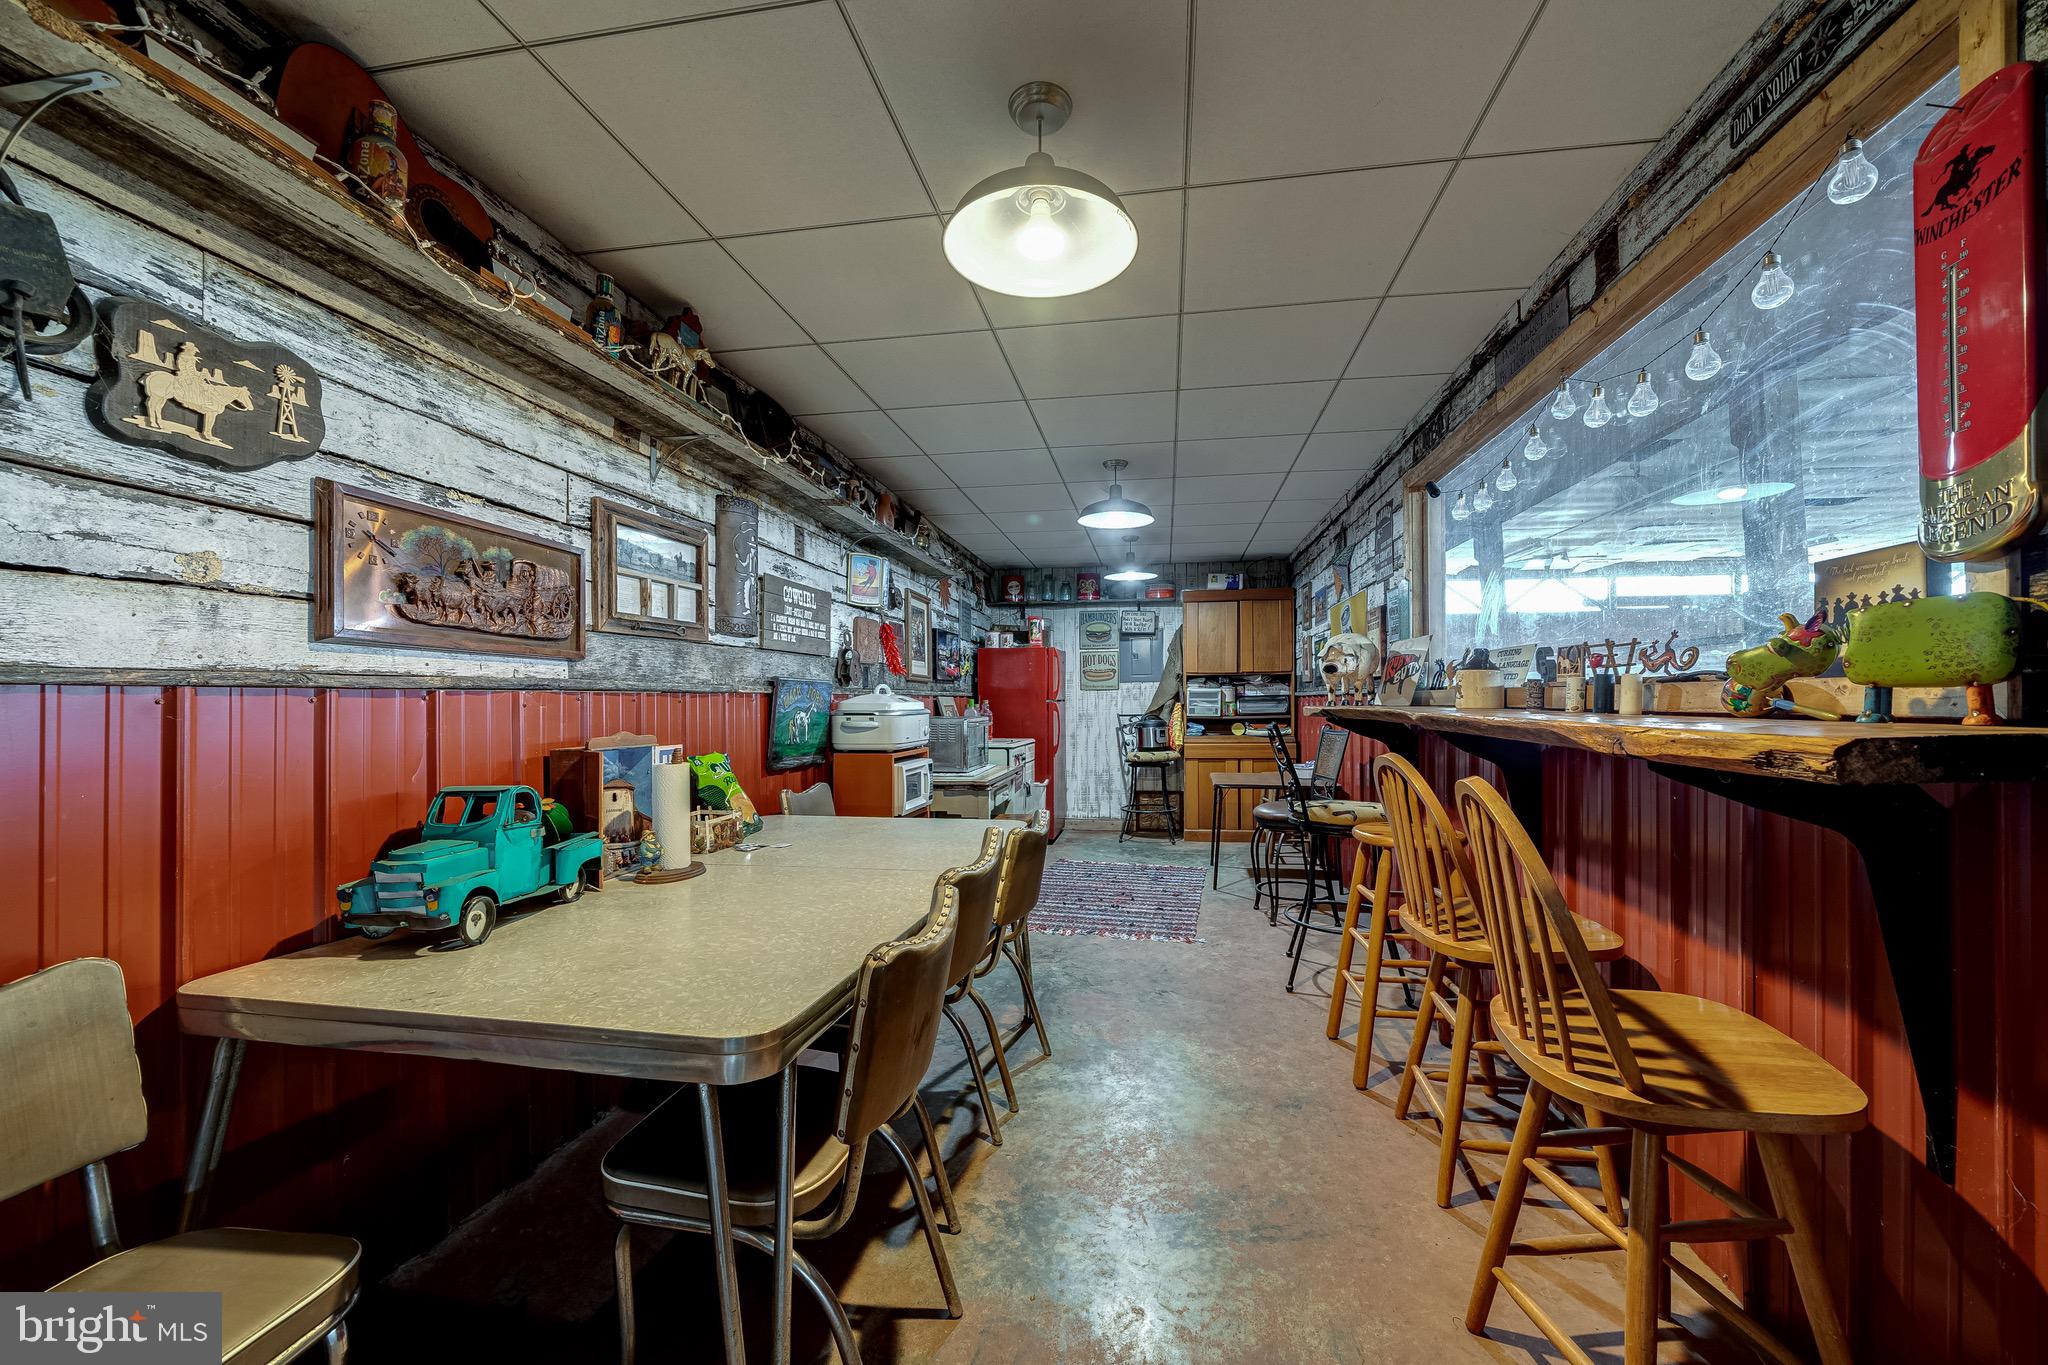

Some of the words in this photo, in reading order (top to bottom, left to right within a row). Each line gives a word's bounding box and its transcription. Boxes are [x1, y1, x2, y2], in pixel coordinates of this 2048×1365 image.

[1732, 94, 1764, 143] DON'T
[1766, 52, 1803, 108] SQUAT
[1915, 157, 2022, 247] WINCHESTER
[1960, 238, 1967, 248] F
[1922, 477, 2016, 523] AMERICAN
[1939, 479, 1974, 504] THE
[1924, 501, 2016, 544] LEGEND
[783, 585, 817, 610] COWGIRL
[1080, 612, 1117, 626] HAMBURGERS
[1082, 655, 1098, 668] HOT
[1098, 654, 1117, 667] DOGS
[1499, 659, 1530, 669] LANGUAGE
